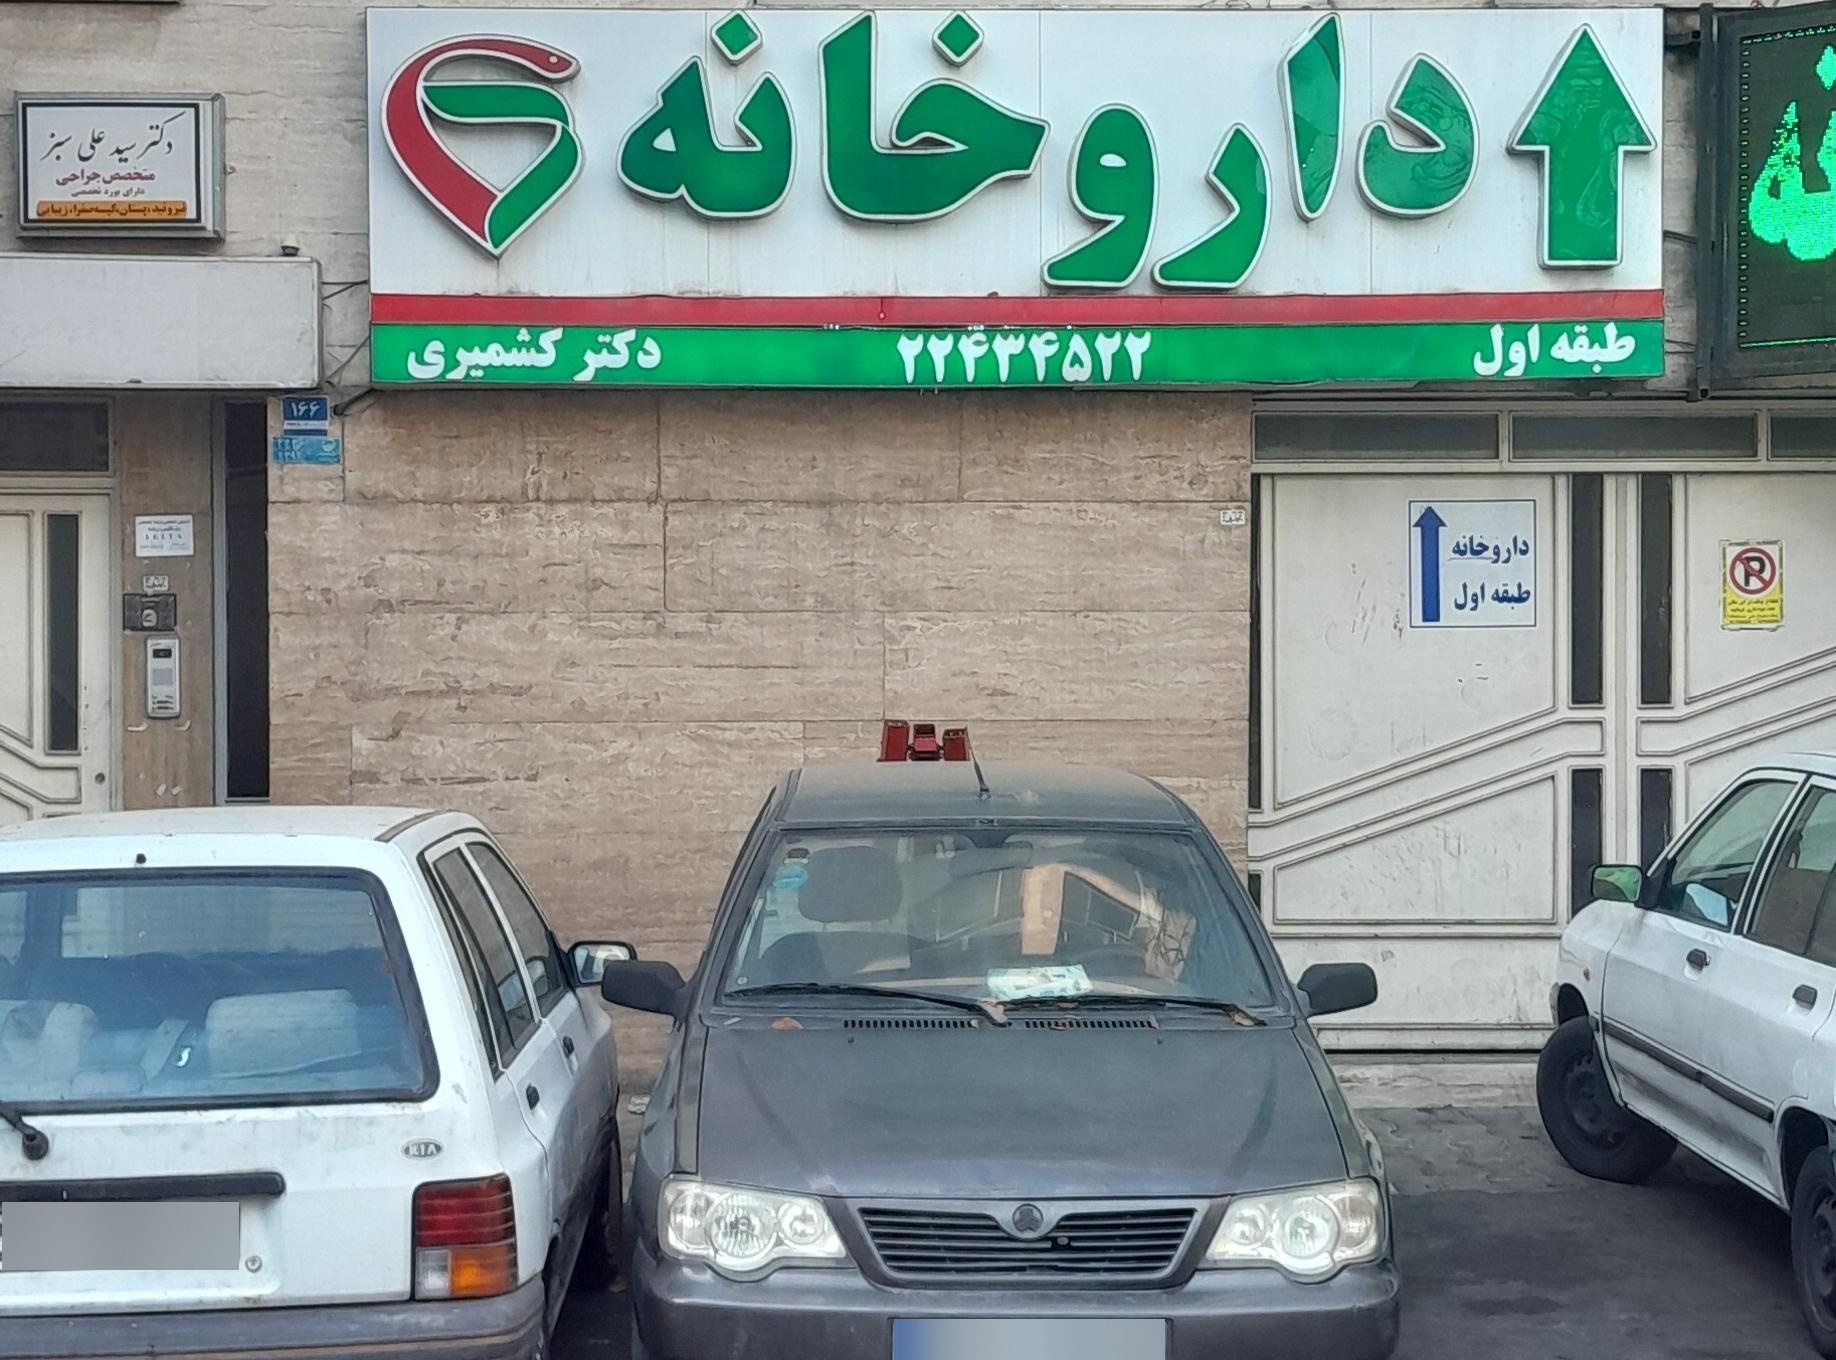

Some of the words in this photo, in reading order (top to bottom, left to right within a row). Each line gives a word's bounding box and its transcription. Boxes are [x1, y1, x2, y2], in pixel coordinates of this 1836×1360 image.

[40, 132, 72, 161] سبز
[77, 128, 106, 163] علی
[136, 110, 187, 160] دکتر
[616, 8, 1480, 288] داروخانه
[109, 142, 137, 163] سید
[56, 168, 100, 186] جراحی
[102, 166, 155, 185] متخصص
[406, 327, 564, 380] کشمیری
[572, 328, 662, 382] دکتر
[896, 331, 1152, 384] ۲۲۴۳۴۵۲۲
[1473, 323, 1541, 377] اول
[1550, 322, 1636, 374] طبقه
[291, 401, 321, 418] ۱۶۶
[1452, 534, 1530, 564] داروخانه
[1454, 582, 1486, 611] اول
[1491, 582, 1531, 610] طبقه
[409, 1142, 438, 1157] KIA
